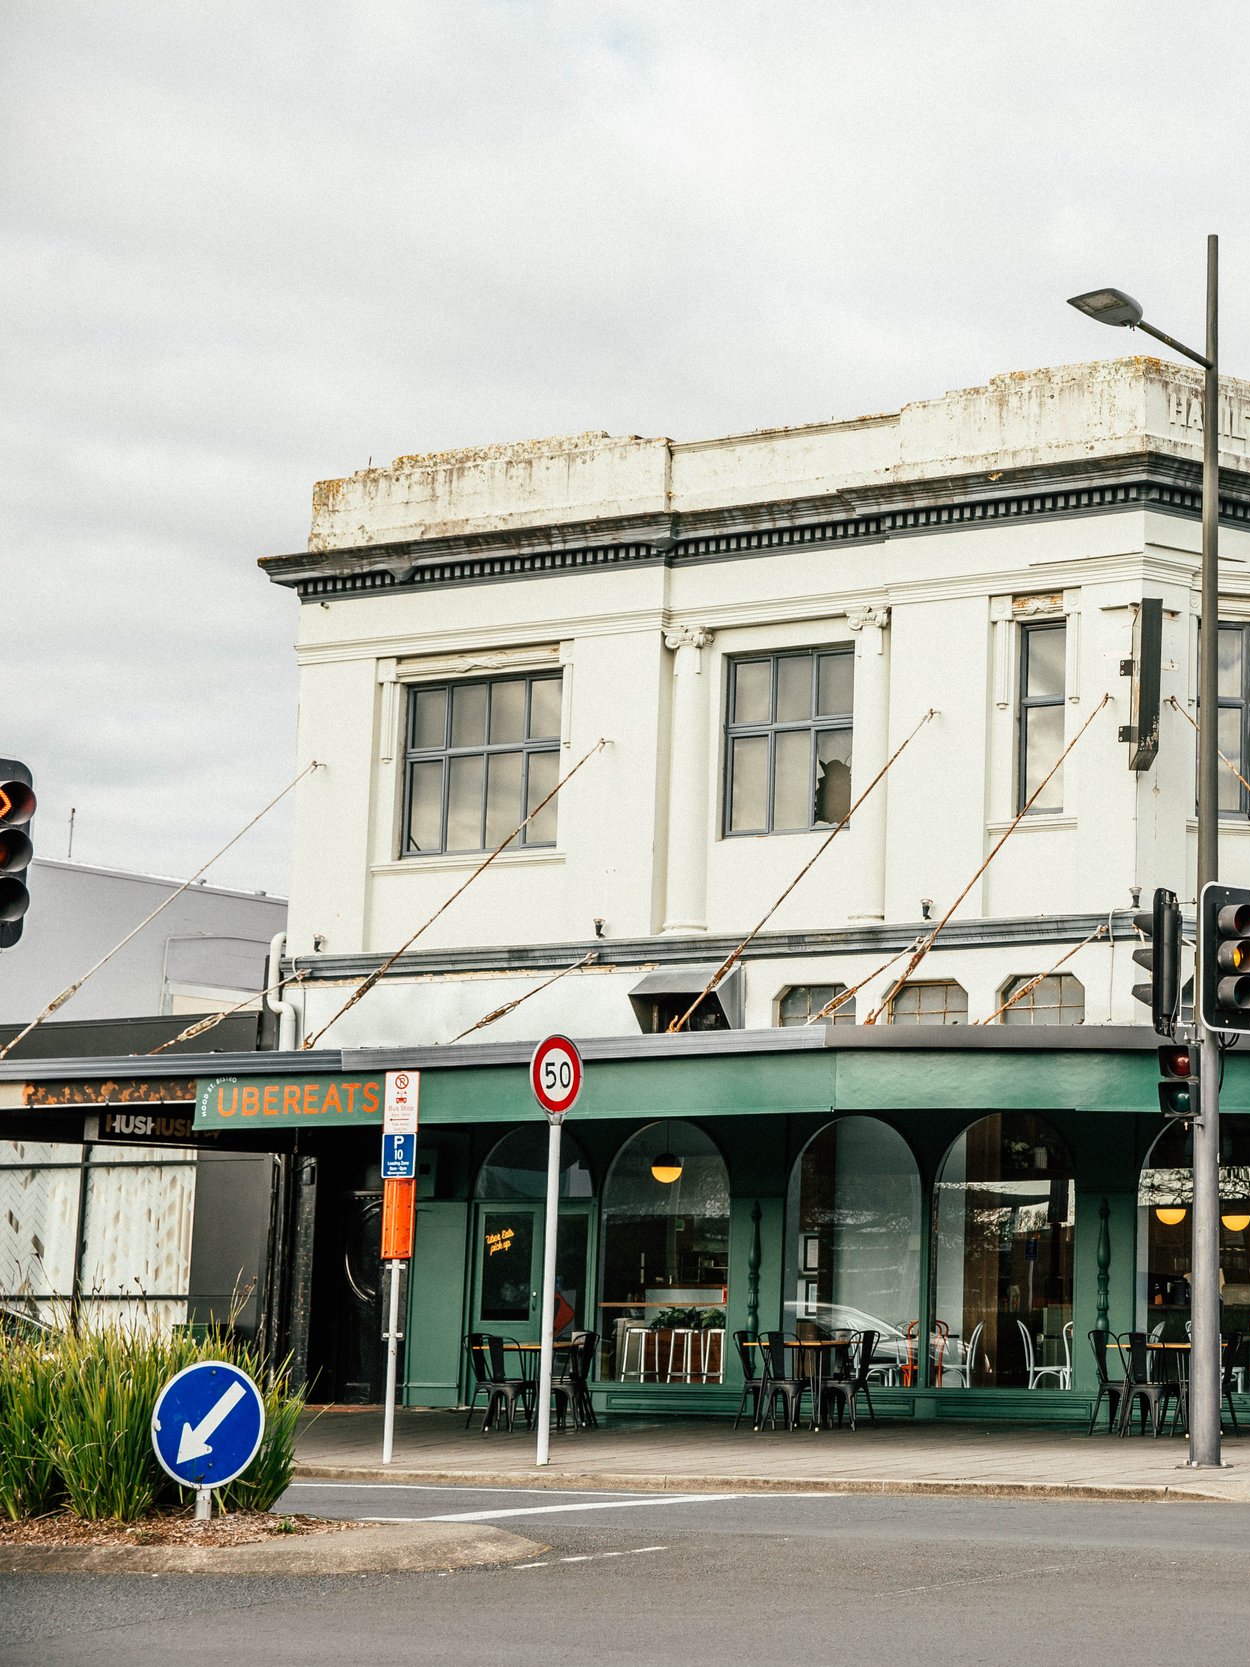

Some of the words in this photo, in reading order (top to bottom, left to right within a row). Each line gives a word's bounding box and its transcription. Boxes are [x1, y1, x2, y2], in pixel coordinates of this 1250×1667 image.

[545, 1061, 571, 1089] 50
[217, 1082, 380, 1117] UBEREATS
[394, 1135, 405, 1150] P
[394, 1149, 403, 1161] 10
